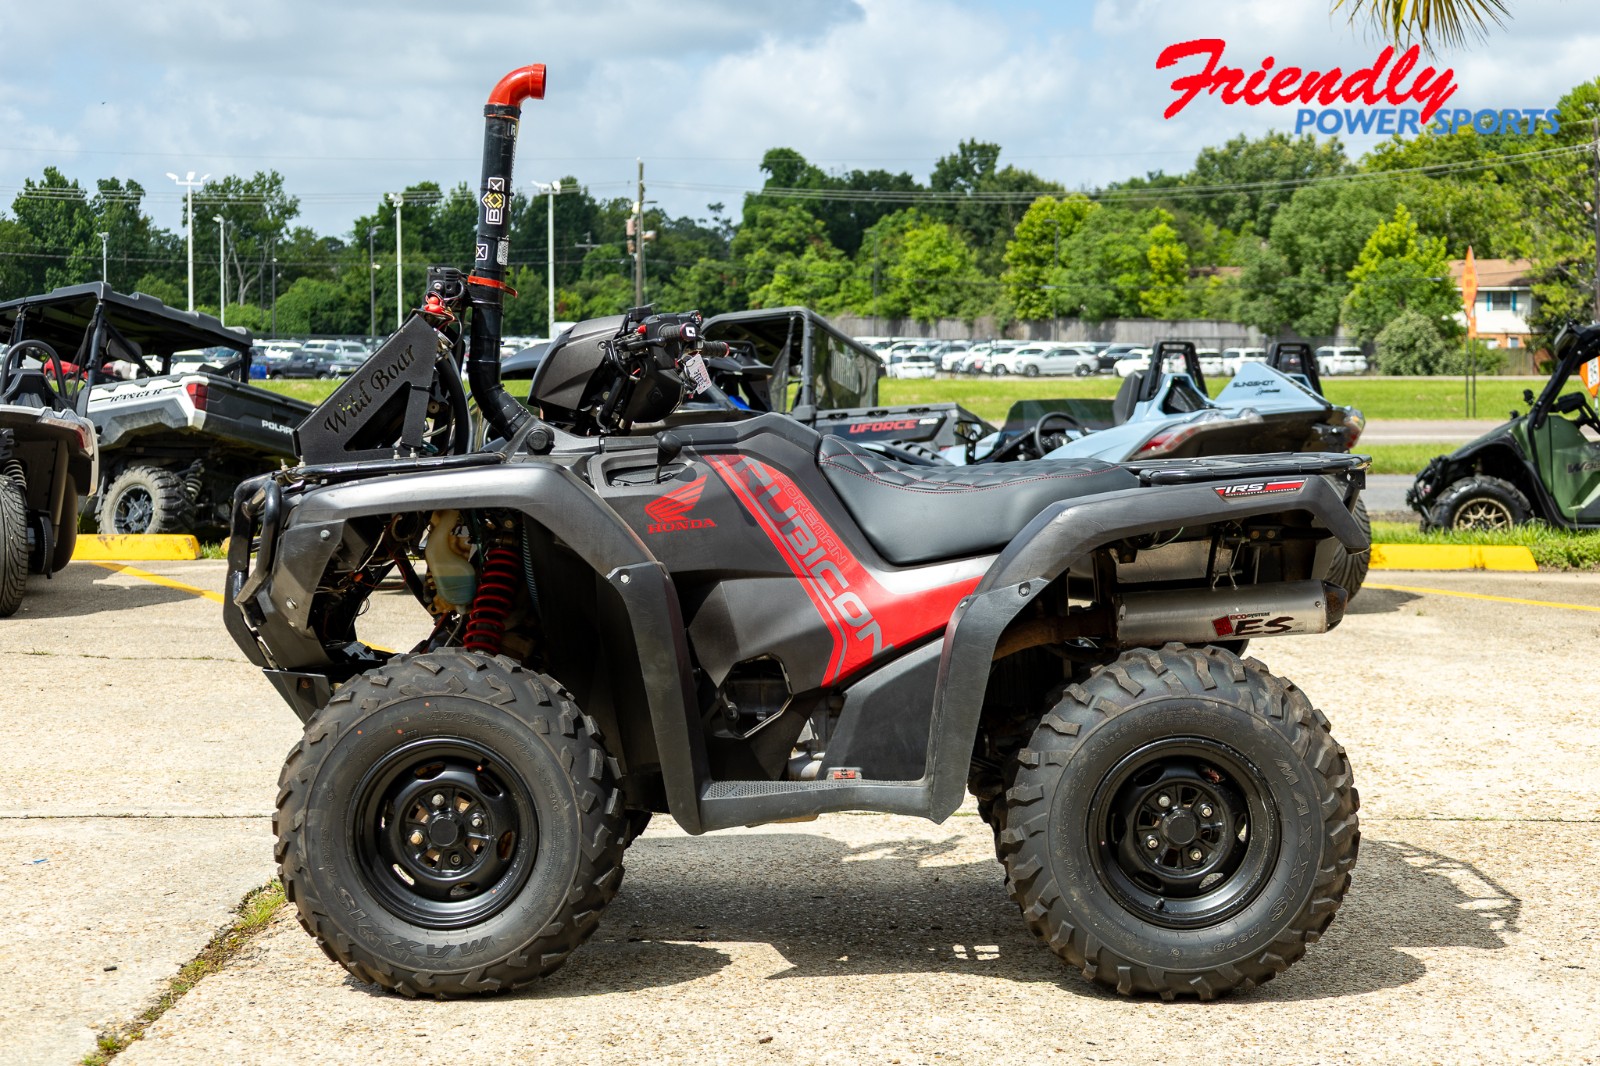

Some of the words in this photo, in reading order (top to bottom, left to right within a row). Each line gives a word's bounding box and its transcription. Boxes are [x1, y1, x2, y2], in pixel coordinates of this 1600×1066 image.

[324, 379, 373, 433] Wild
[370, 344, 416, 392] Boar
[261, 419, 294, 435] POLAR
[849, 419, 917, 434] UFORCE
[1225, 482, 1265, 494] IRS
[647, 518, 717, 534] HONDA
[773, 471, 848, 566] FOREMAN
[733, 456, 895, 661] RUBICON
[1233, 616, 1294, 636] ES
[1269, 758, 1312, 922] MAXXIS
[334, 886, 493, 958] MAXXIS
